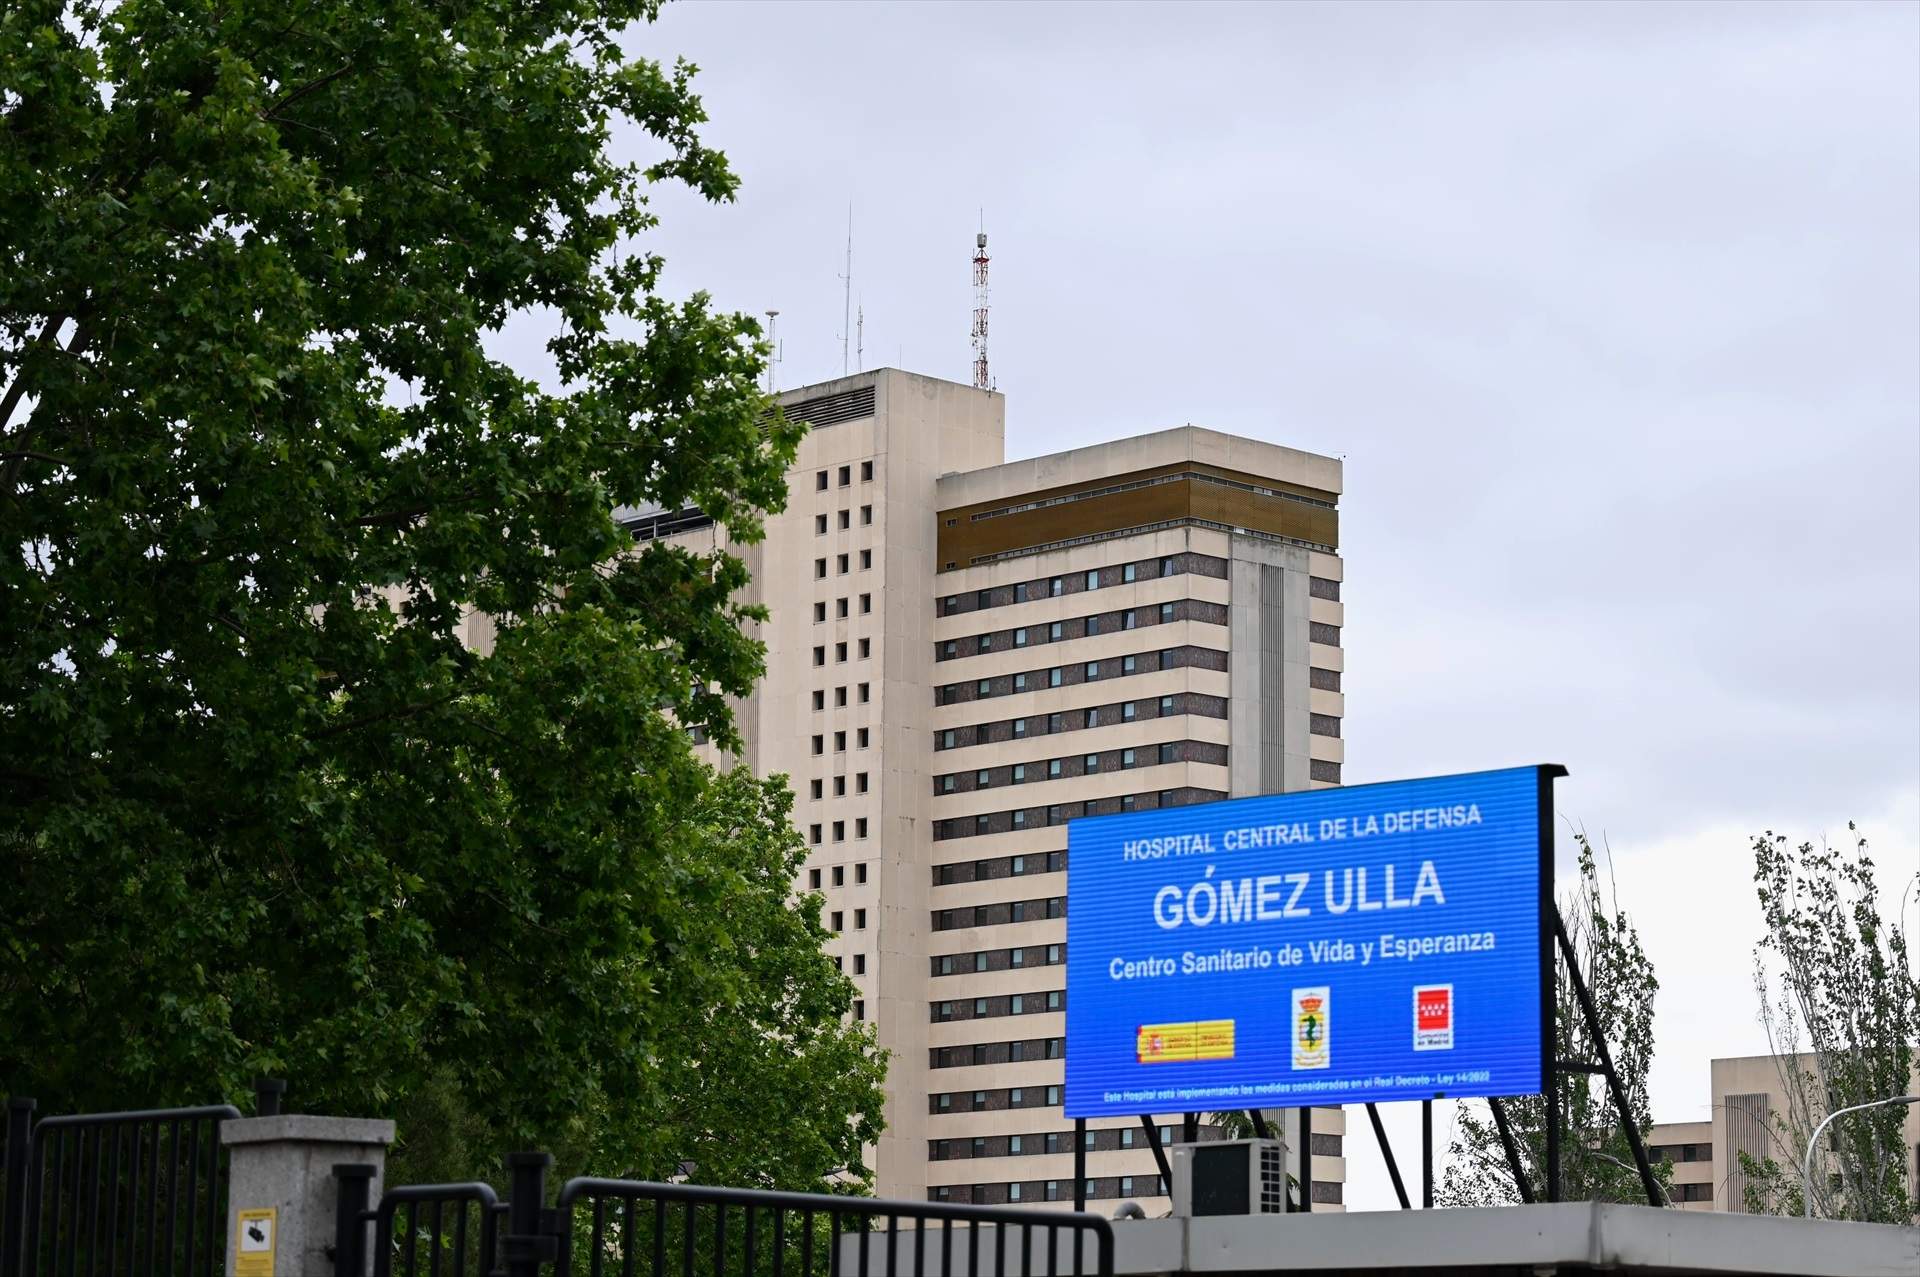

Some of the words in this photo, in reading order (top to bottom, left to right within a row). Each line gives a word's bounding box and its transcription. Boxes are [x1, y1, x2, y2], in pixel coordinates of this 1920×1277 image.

[1124, 834, 1216, 861] HOSPITAL
[1223, 824, 1314, 851] CENTRAL
[1320, 818, 1347, 841] DE
[1353, 814, 1379, 837] LA
[1384, 804, 1482, 834] DEFENSA
[1153, 865, 1310, 930] GÓMEZ
[1324, 860, 1445, 914] ULLA
[1109, 957, 1176, 980] Centro
[1182, 946, 1272, 974] Sanitario
[1278, 944, 1303, 966] de
[1309, 939, 1355, 963] Vida
[1361, 943, 1374, 966] y
[1381, 932, 1495, 961] Esperanza
[1103, 1092, 1122, 1103] Este
[1123, 1091, 1157, 1103] Hospital
[1176, 1085, 1240, 1099] implementando
[1255, 1083, 1291, 1094] medidas
[1350, 1080, 1362, 1089] en
[1374, 1076, 1394, 1087] Real
[1395, 1075, 1430, 1086] Decreto
[1437, 1073, 1454, 1085] Ley
